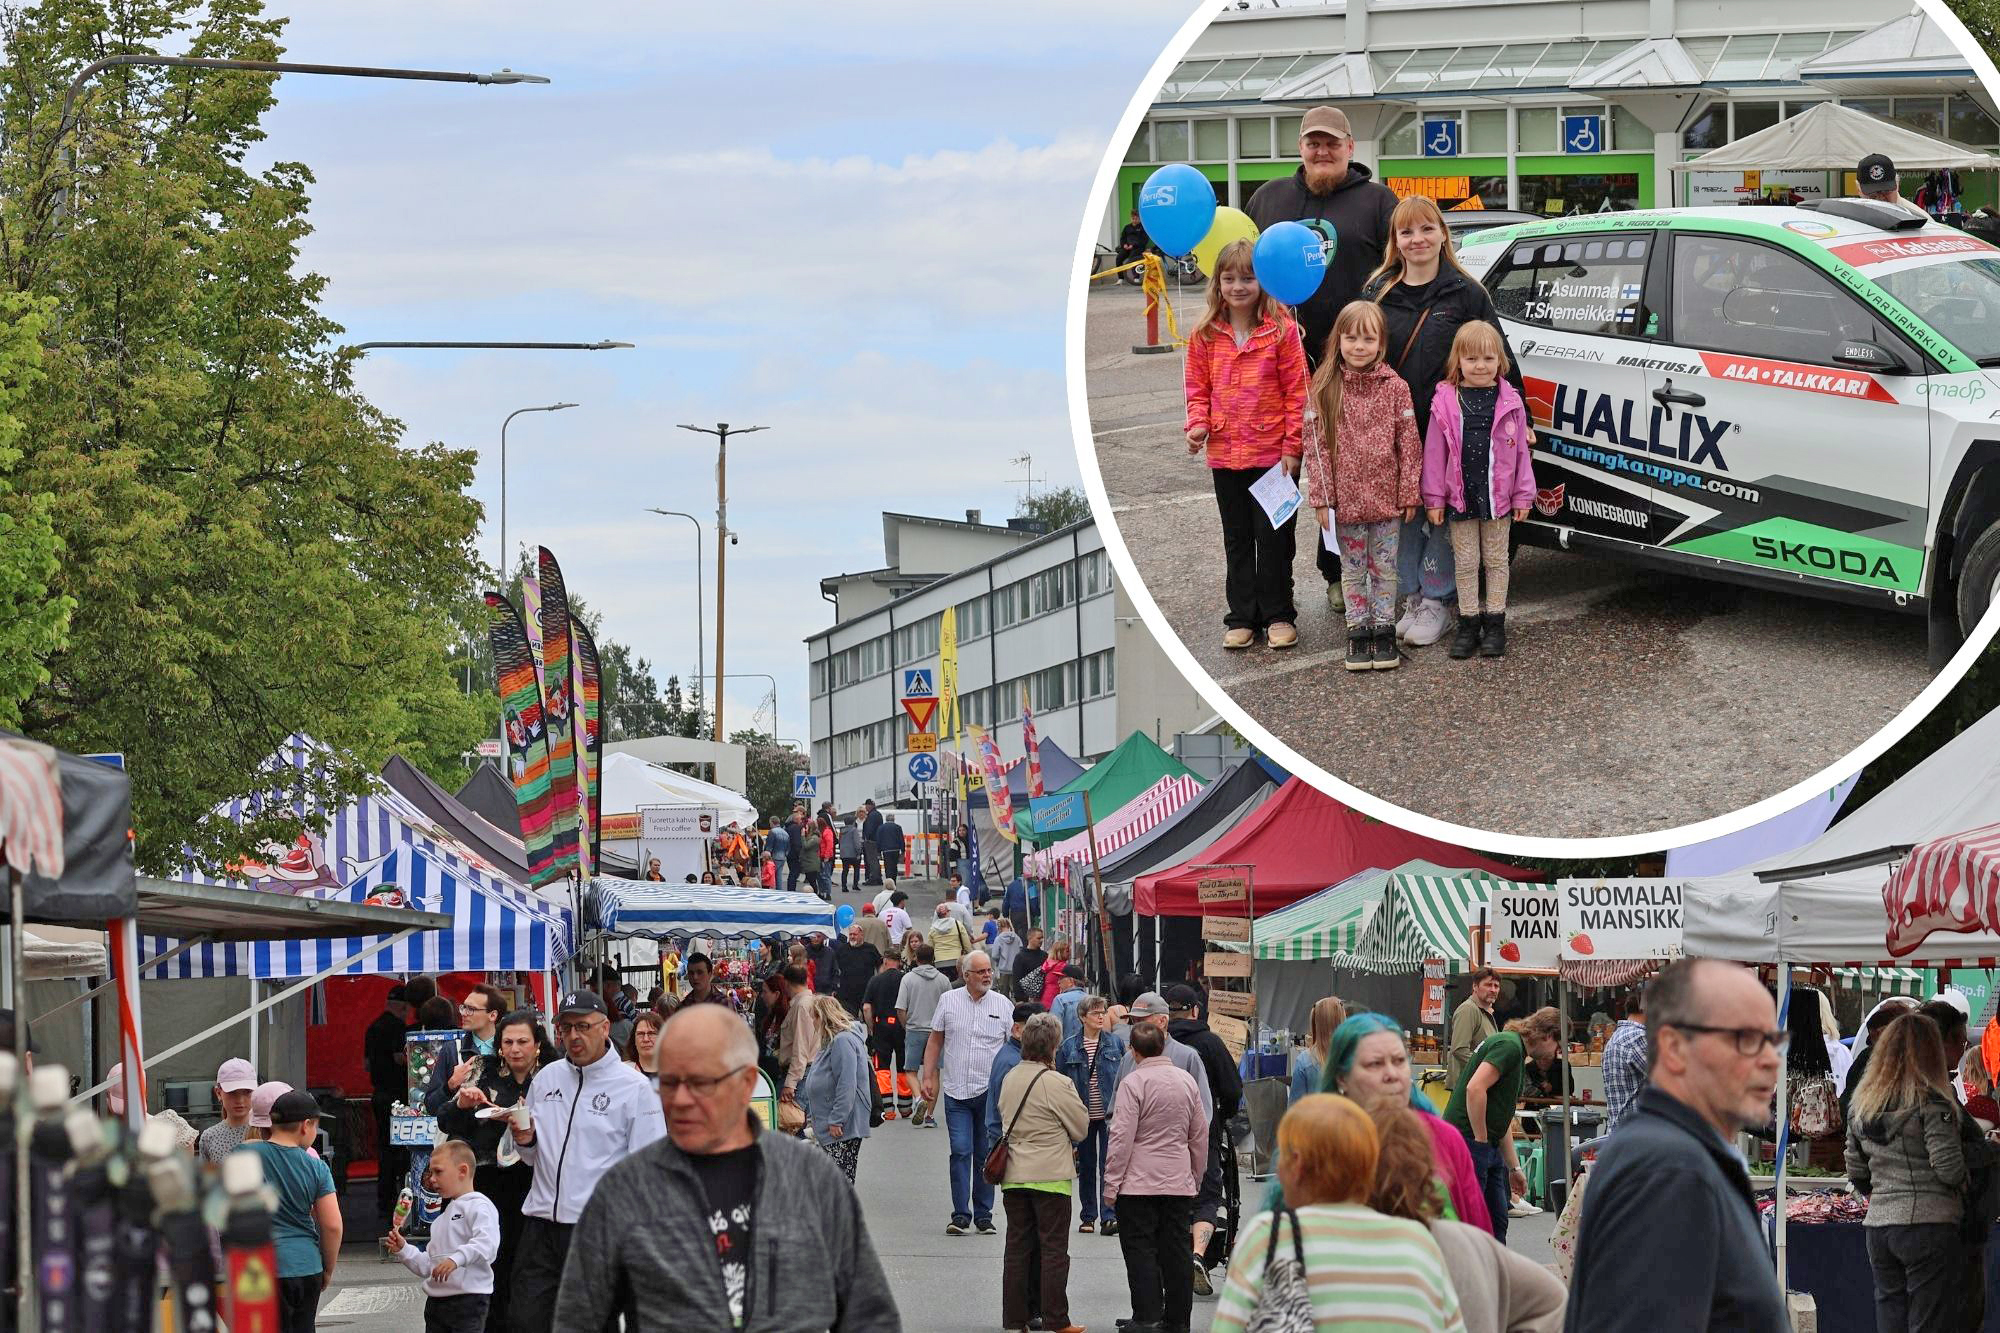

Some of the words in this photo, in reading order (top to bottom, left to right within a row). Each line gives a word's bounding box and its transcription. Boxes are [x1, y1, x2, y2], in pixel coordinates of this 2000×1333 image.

[1388, 177, 1448, 198] VAATTEET
[1455, 177, 1469, 198] JA
[1538, 280, 1620, 299] T.Asunmaa
[1524, 301, 1616, 323] T.Shemeikka
[1866, 288, 1938, 350] VARTIAMÄKI
[1937, 348, 1958, 366] OY
[1533, 343, 1605, 362] FERRAIN
[1722, 363, 1759, 381] ALA
[1772, 369, 1870, 397] TALKKARI
[1567, 494, 1649, 530] KONNEGROUP
[649, 816, 675, 824] Tuoretta
[676, 816, 697, 824] kahvia
[1567, 885, 1682, 907] SUOMALAI
[1501, 897, 1559, 918] SUOM
[1510, 919, 1561, 939] MAN
